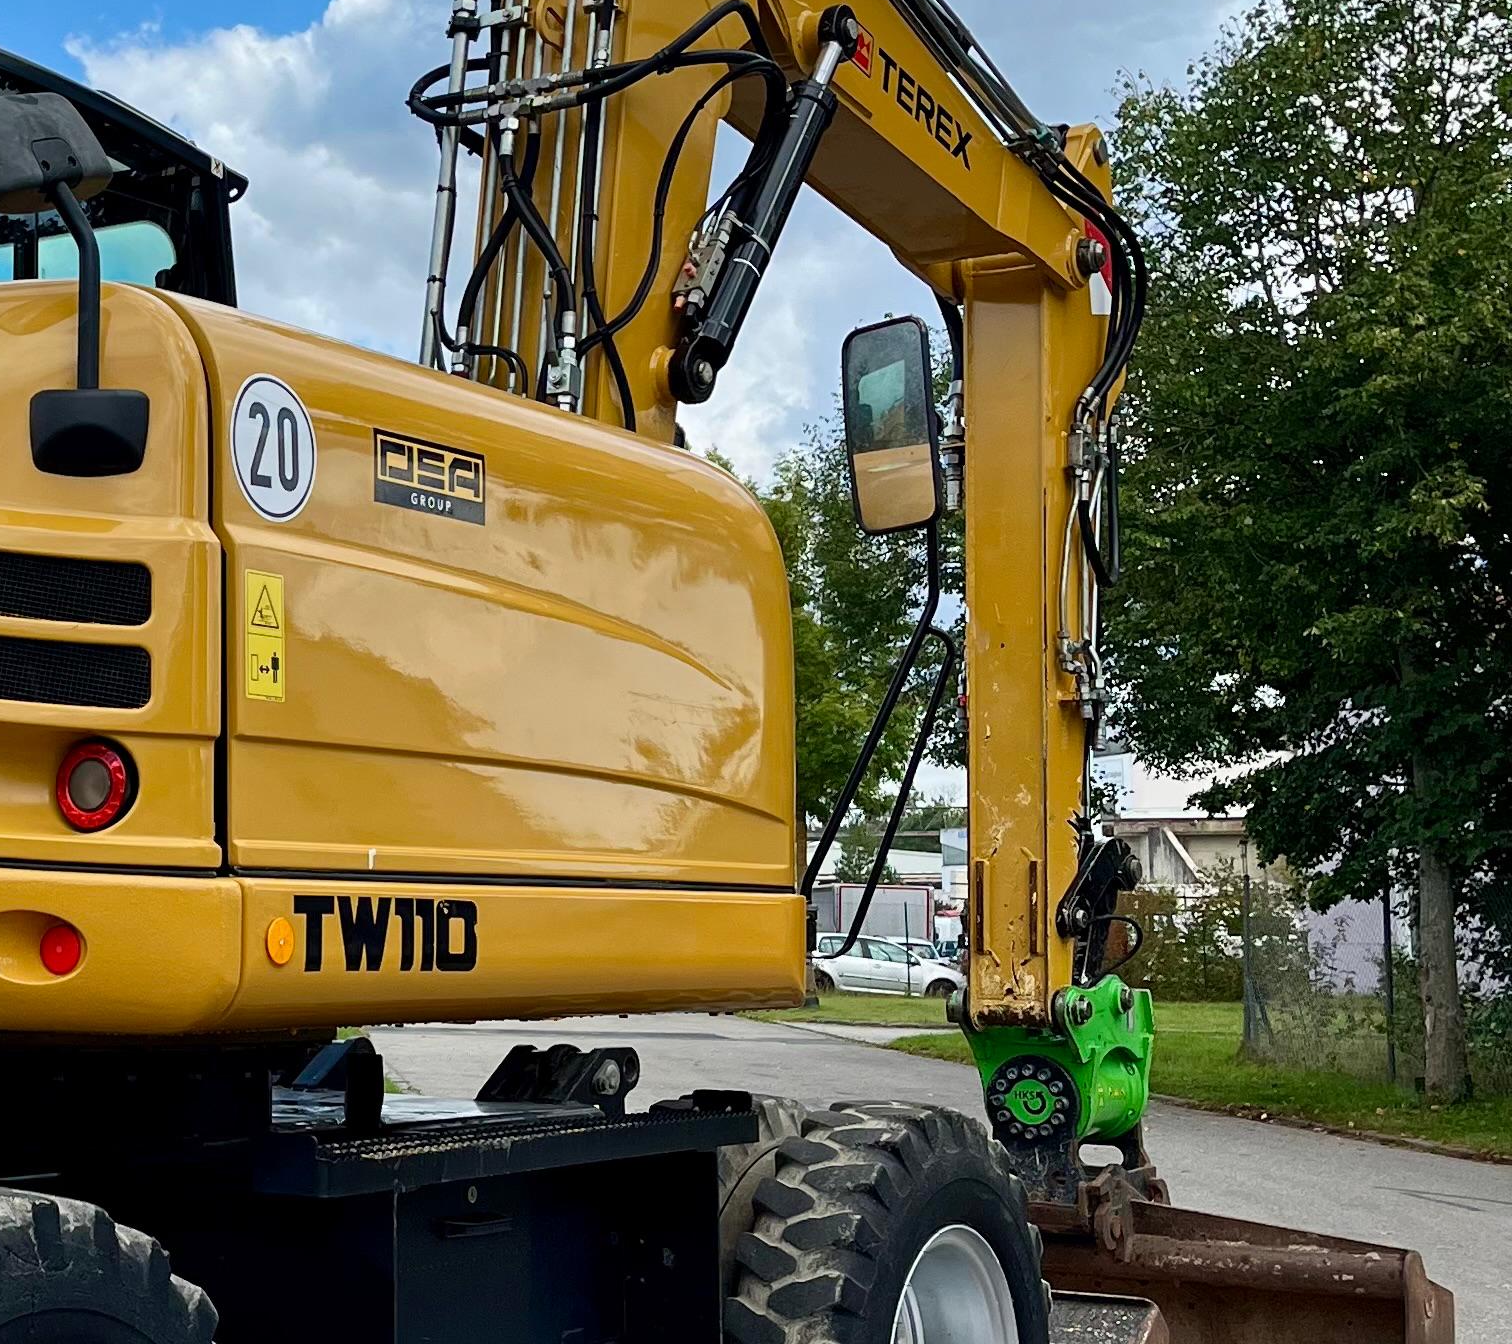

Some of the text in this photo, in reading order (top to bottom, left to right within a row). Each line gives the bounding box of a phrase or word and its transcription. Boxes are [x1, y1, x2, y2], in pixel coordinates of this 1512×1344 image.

[878, 47, 973, 171] TEREX
[248, 401, 299, 492] 20
[410, 492, 452, 512] GROUP
[293, 895, 478, 972] TW110
